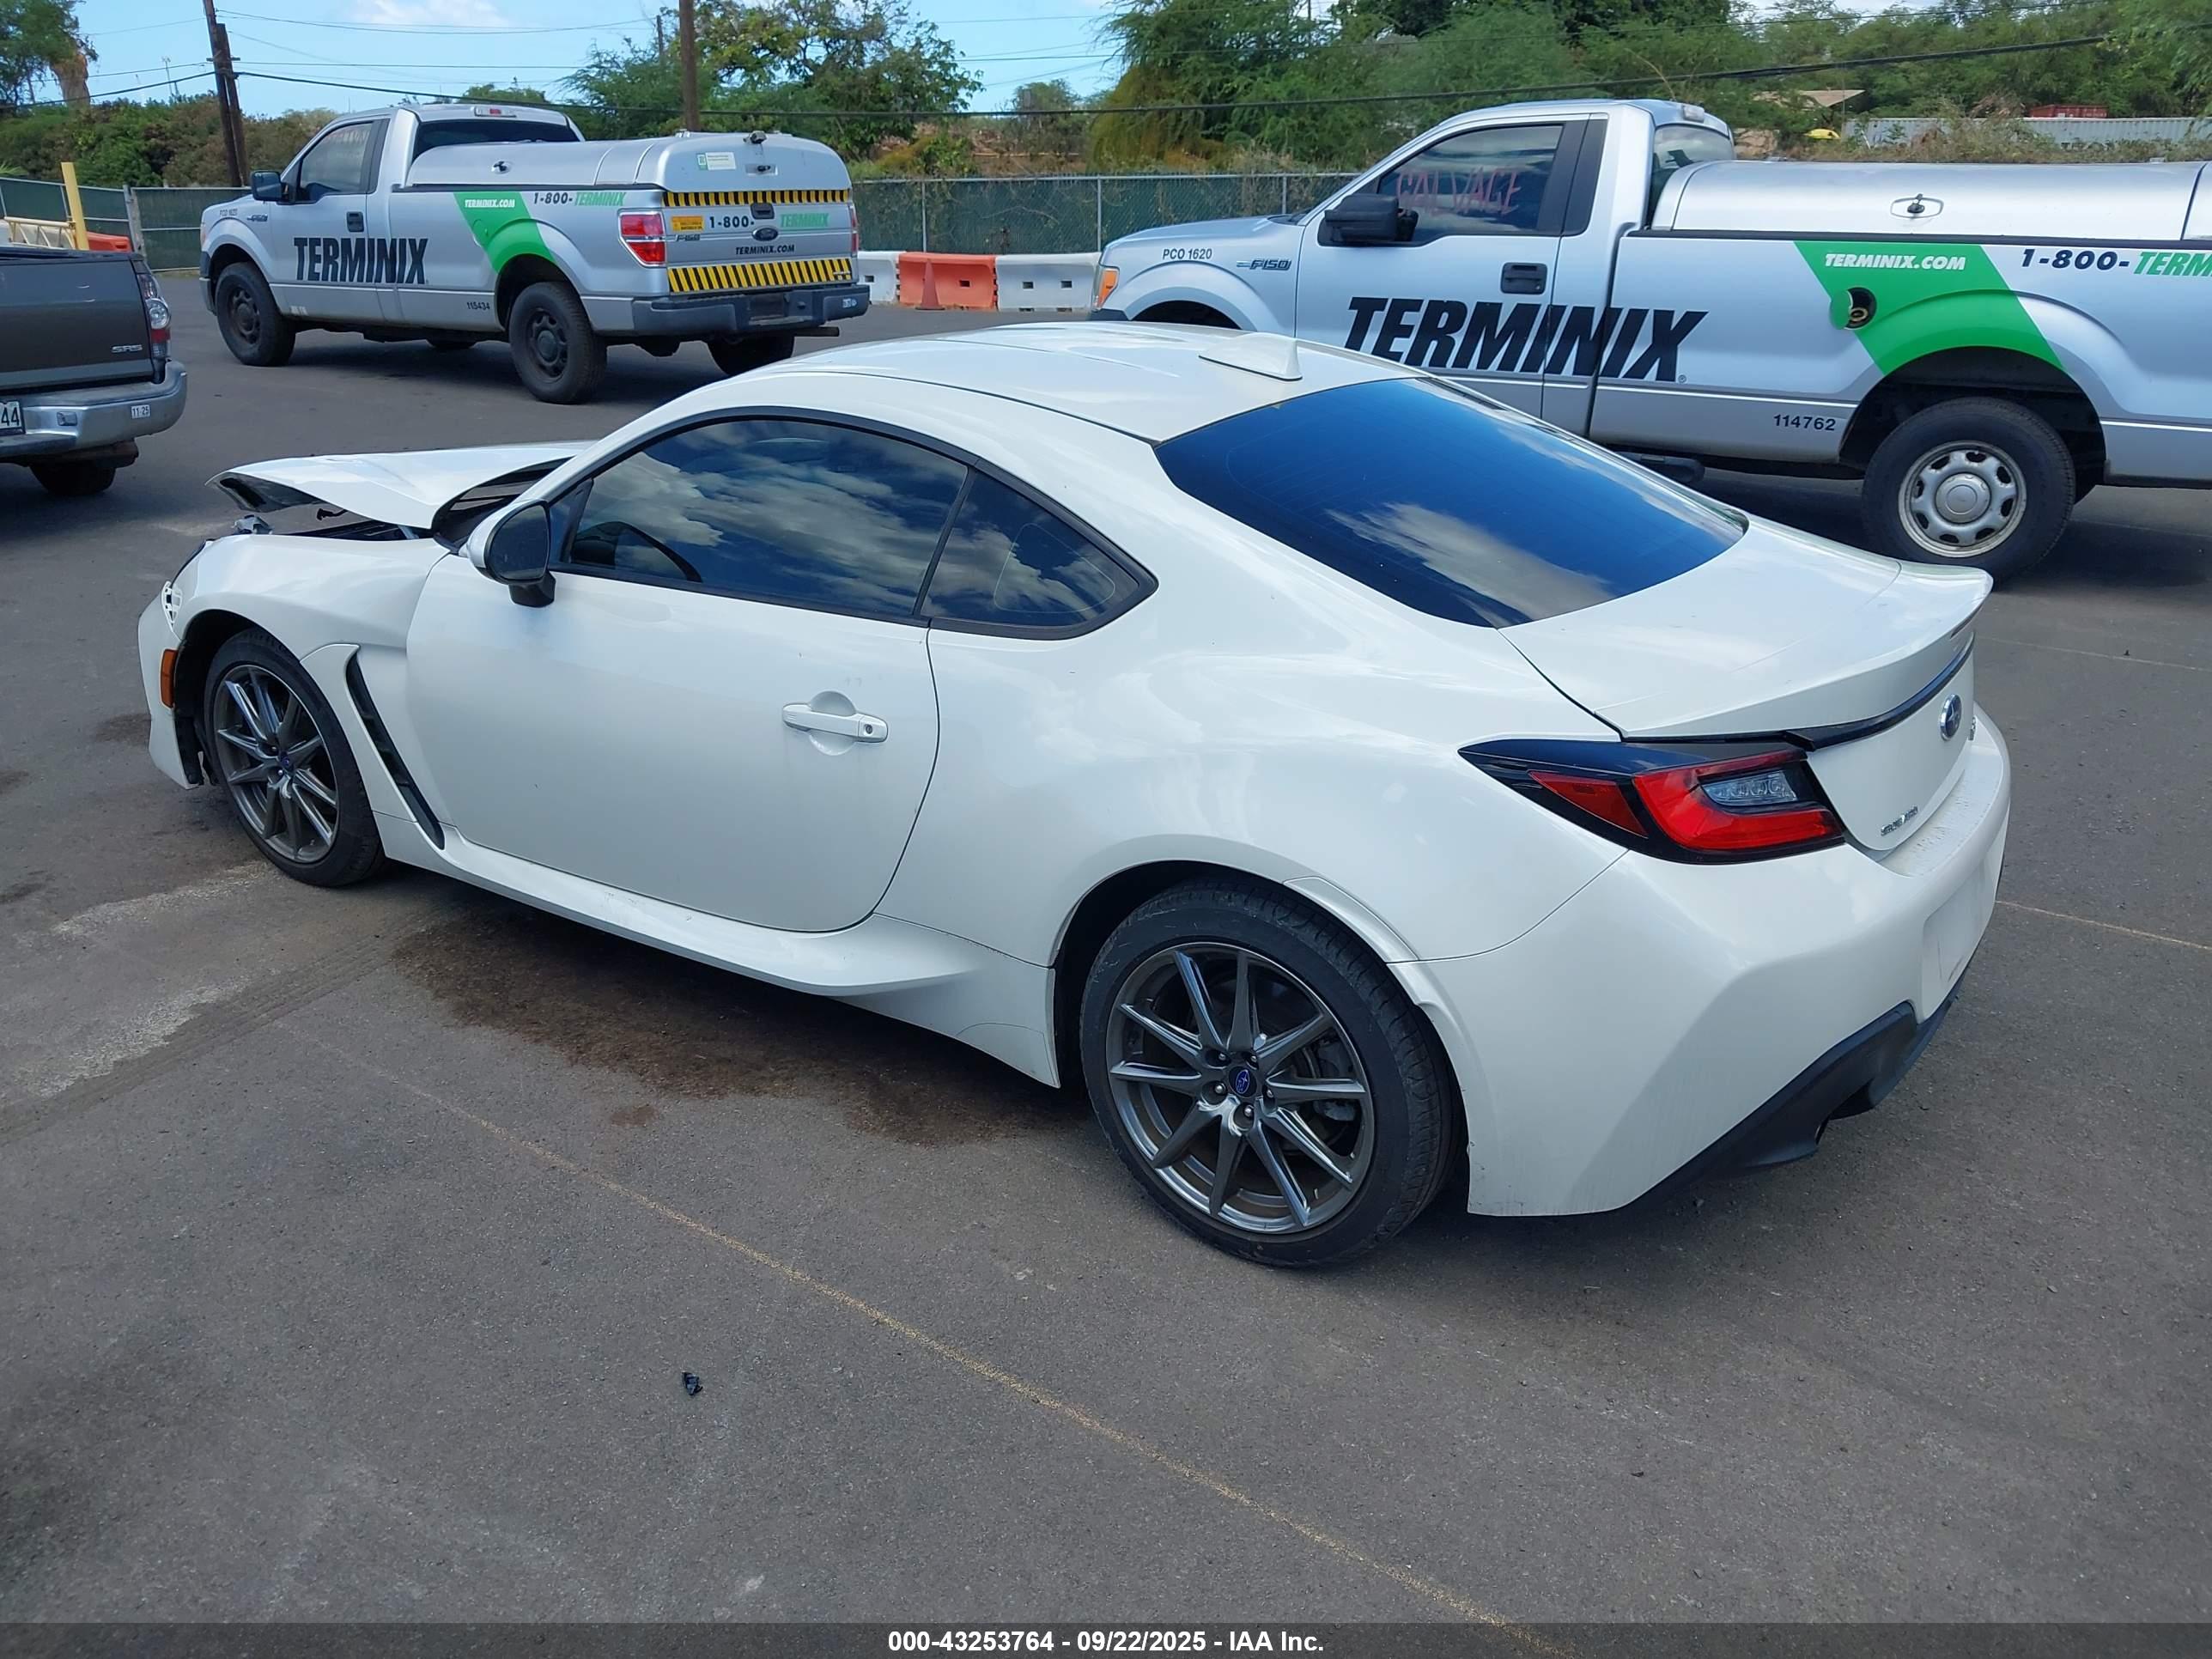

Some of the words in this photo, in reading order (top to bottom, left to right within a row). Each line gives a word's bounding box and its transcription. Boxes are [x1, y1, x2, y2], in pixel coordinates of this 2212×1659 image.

[465, 198, 516, 209] TERMINIX.COM
[781, 213, 830, 228] TERMINIX
[735, 244, 795, 255] TERMINIX.COM
[1163, 248, 1185, 259] PCO
[1188, 248, 1212, 259] 1620
[294, 237, 428, 284] TERMINIX
[1825, 253, 1966, 270] TERMINIX.COM
[1345, 296, 1710, 382] TERMINIX
[131, 406, 149, 416] 11-25
[1773, 414, 1836, 431] 114762
